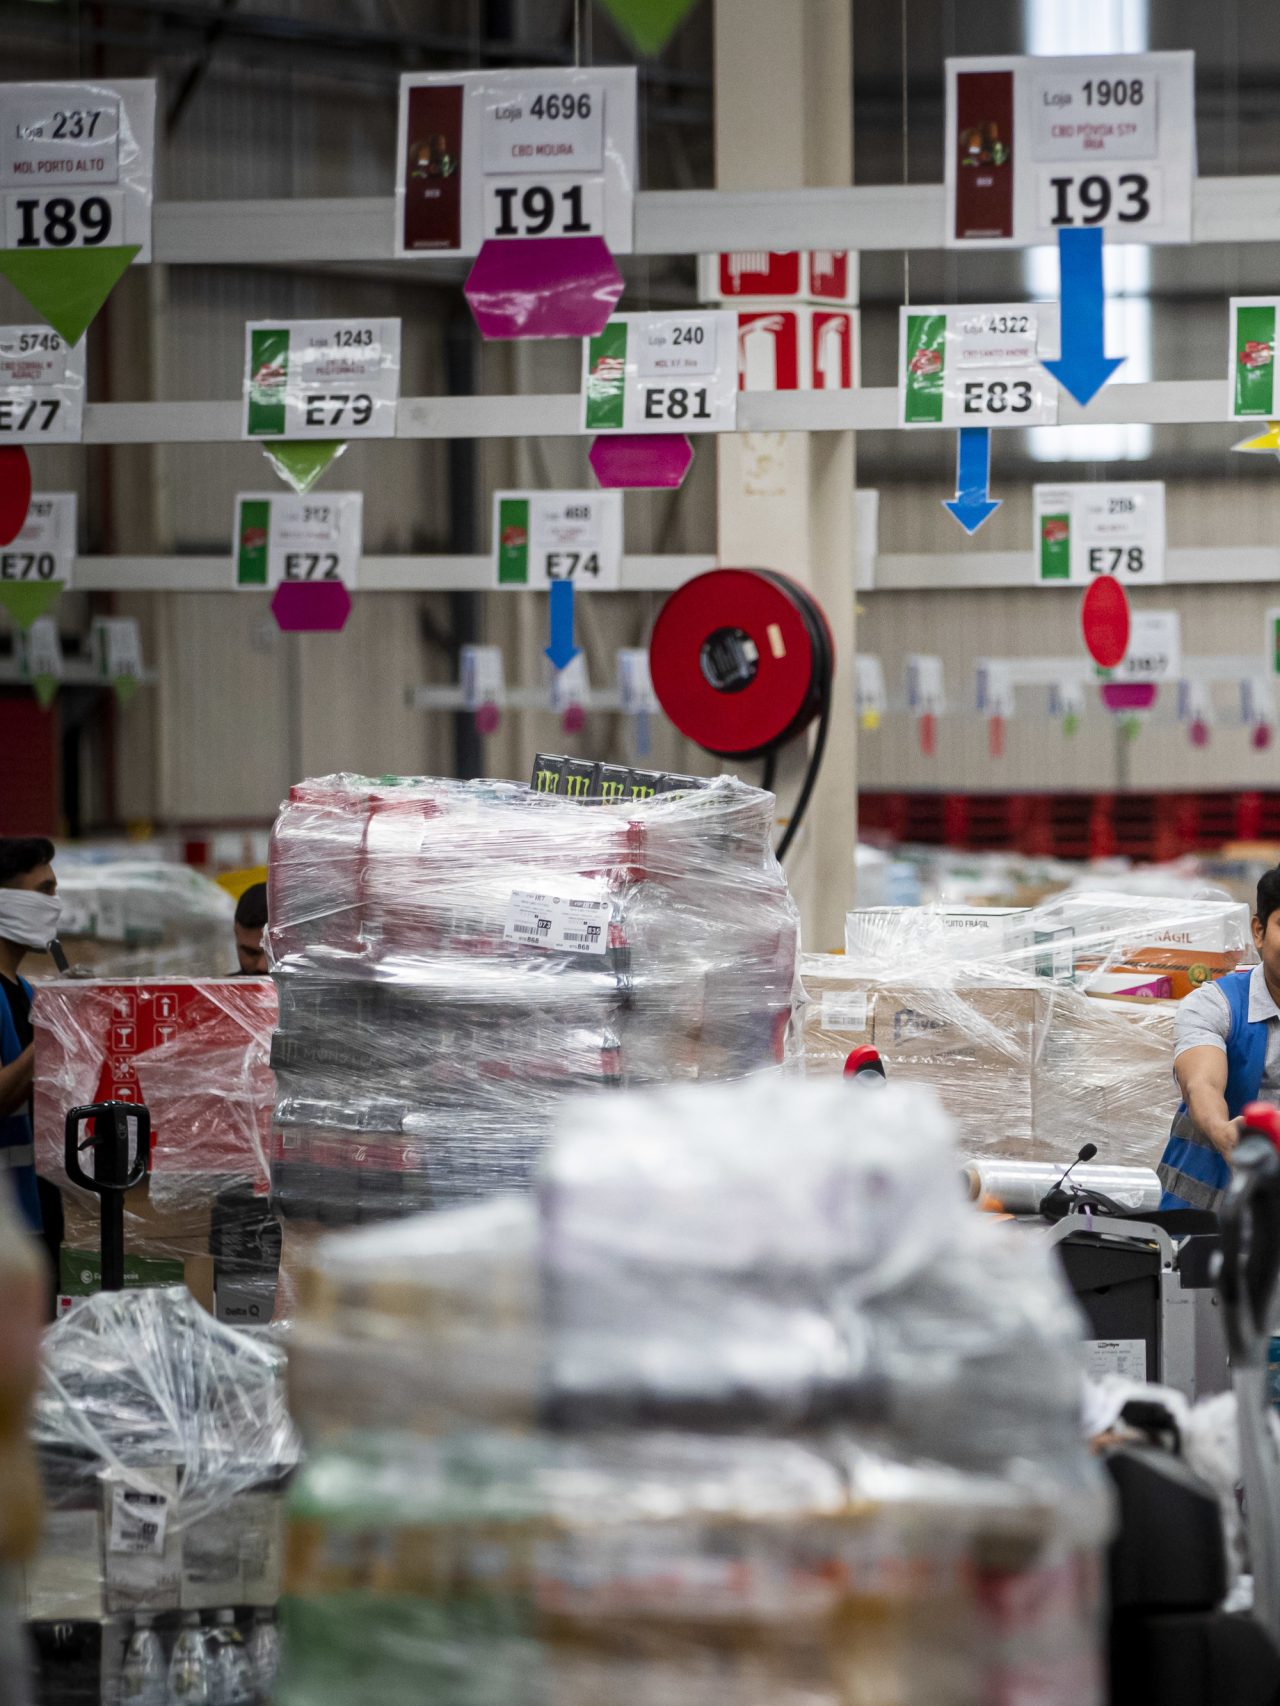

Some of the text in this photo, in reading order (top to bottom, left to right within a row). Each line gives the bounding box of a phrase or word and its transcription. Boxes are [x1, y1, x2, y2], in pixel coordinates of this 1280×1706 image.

[495, 93, 591, 121] Loja 4696
[1043, 79, 1145, 107] Loja 1908
[52, 111, 102, 140] 237
[512, 146, 534, 157] CBD
[37, 161, 74, 173] PORTO
[75, 159, 105, 172] ALTO
[494, 185, 591, 237] I91
[1049, 174, 1151, 226] I93
[16, 197, 112, 247] I89
[334, 330, 372, 347] 1243
[672, 327, 704, 346] 240
[988, 316, 1028, 334] 4322
[305, 394, 372, 426] E79
[644, 387, 712, 420] E81
[963, 381, 1033, 413] E83
[0, 400, 60, 432] E77
[1, 552, 55, 580] E70
[284, 552, 339, 580] E72
[546, 552, 600, 580] E74
[1088, 546, 1144, 575] E78
[943, 918, 989, 928] UITO FRÁGIL
[1154, 929, 1193, 944] ÁGIL
